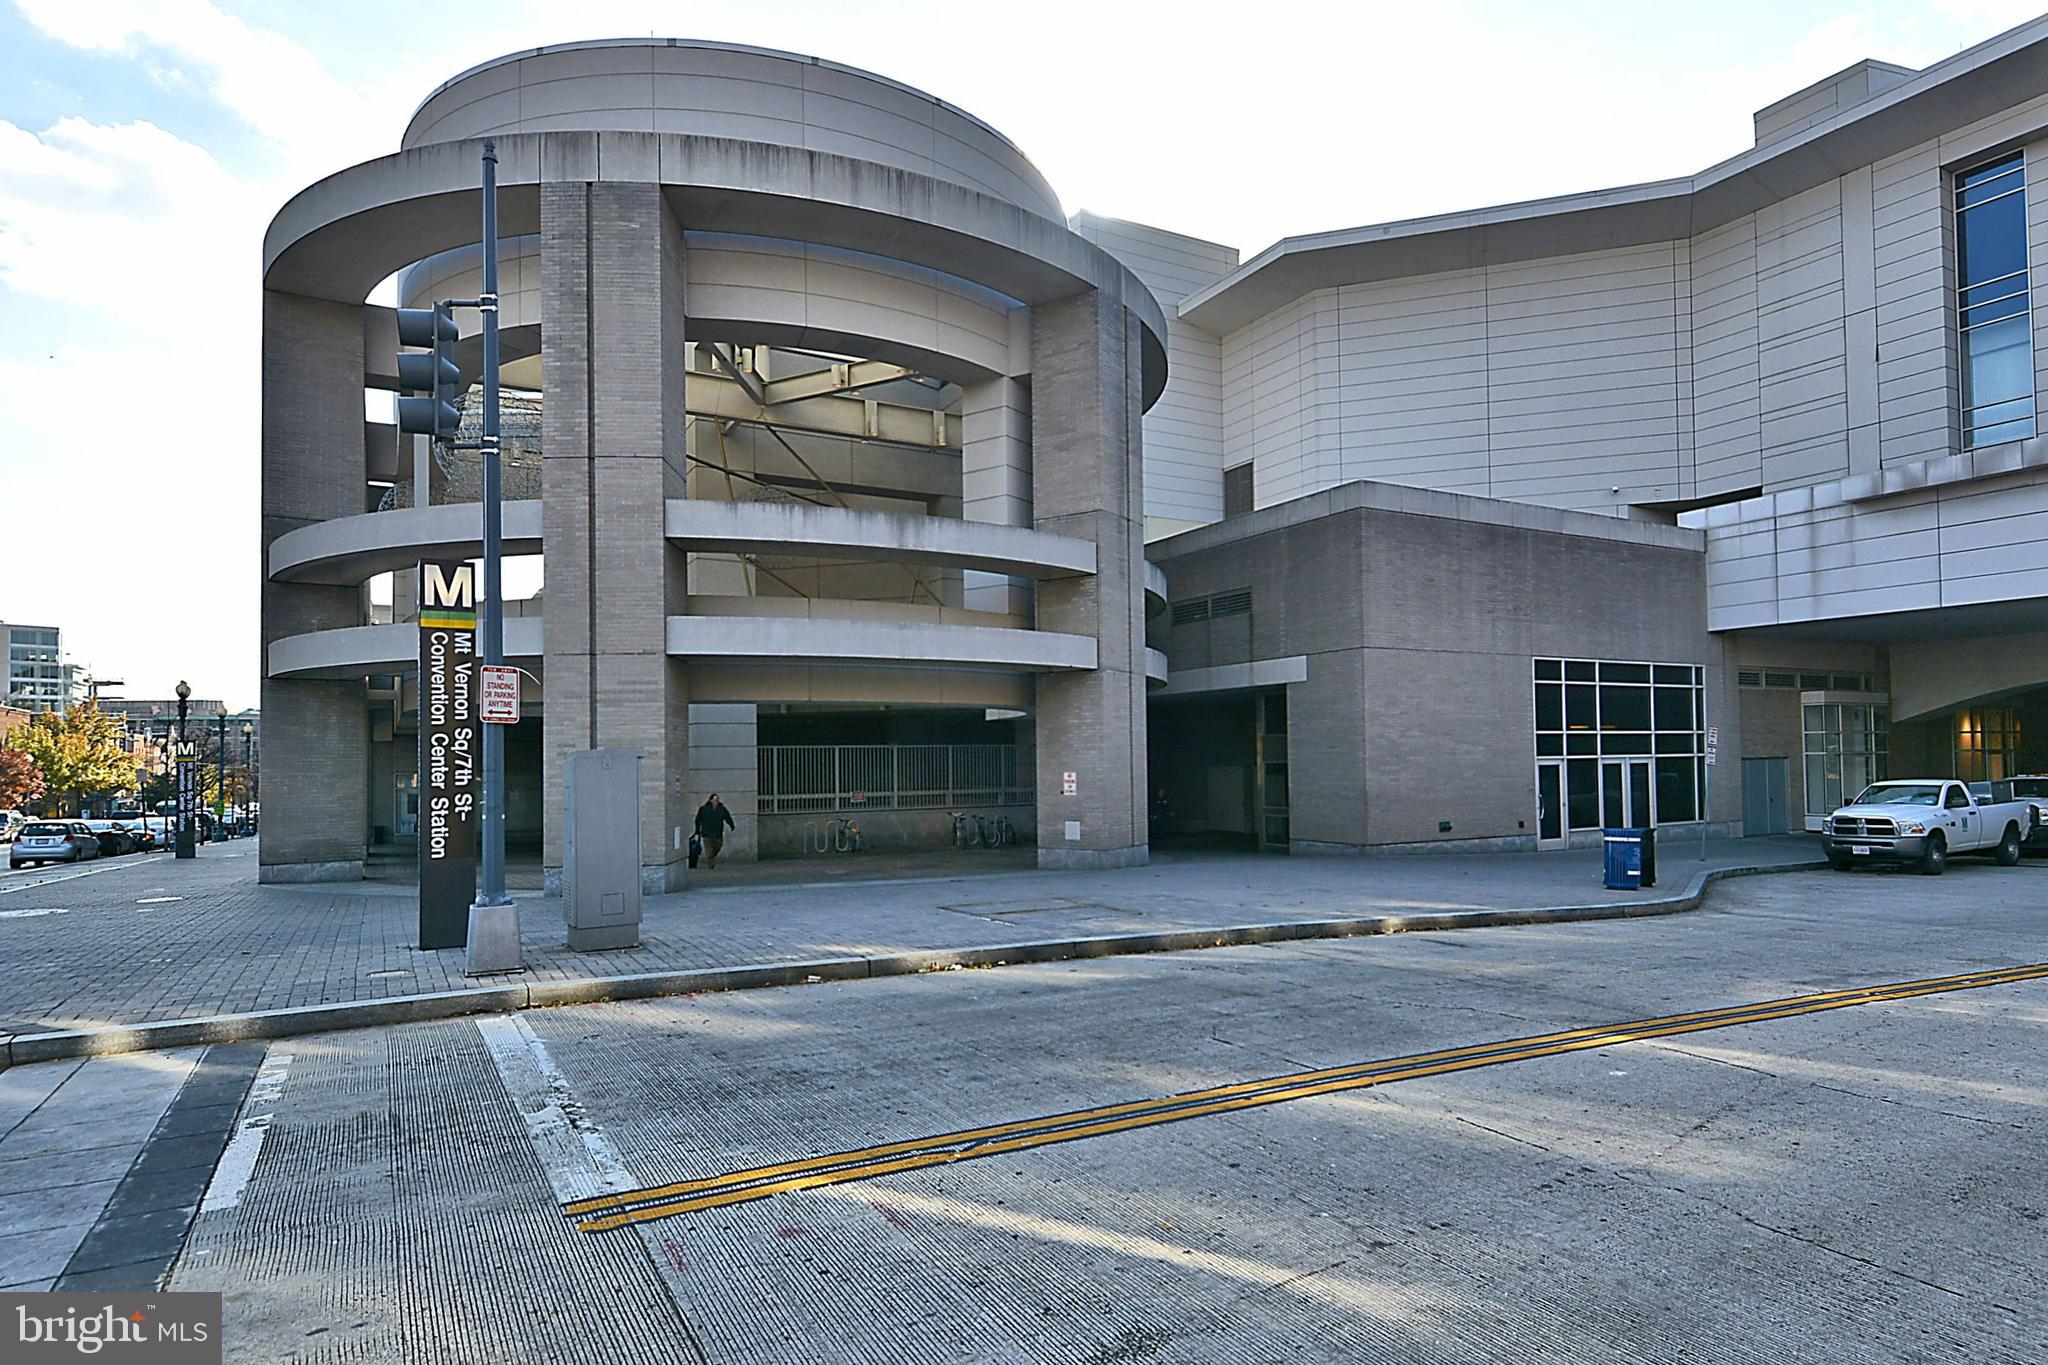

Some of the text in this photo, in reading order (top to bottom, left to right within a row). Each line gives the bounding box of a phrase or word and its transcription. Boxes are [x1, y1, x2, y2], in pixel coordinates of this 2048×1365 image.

[424, 564, 472, 608] M
[487, 682, 514, 690] STANDING
[494, 691, 515, 699] PARKING
[488, 700, 513, 708] ANYTIME
[451, 632, 472, 821] Mt Vernon Sq/7th St-
[177, 742, 194, 755] M
[430, 631, 449, 859] Convention Center Station
